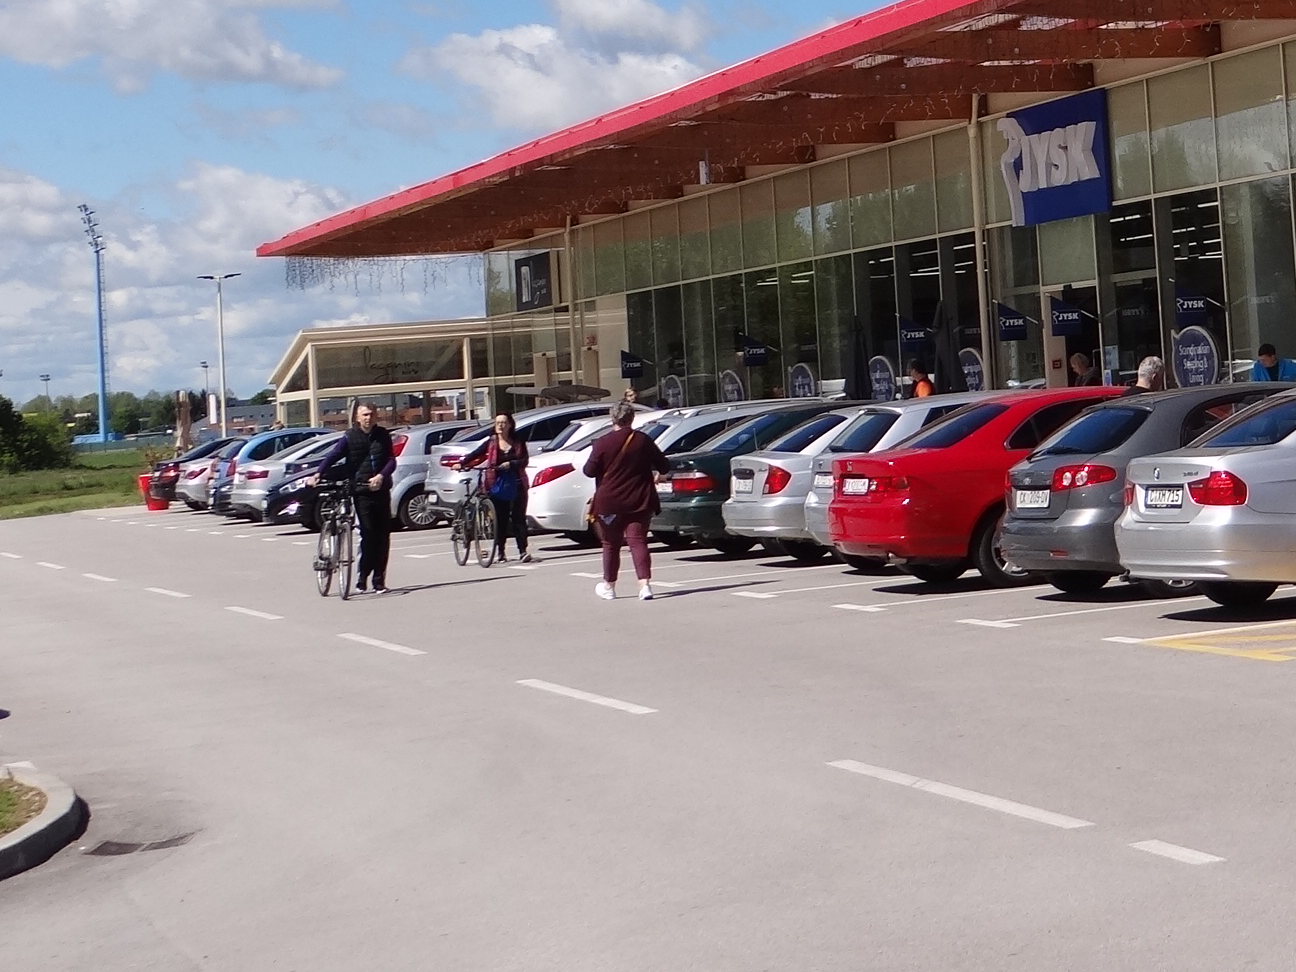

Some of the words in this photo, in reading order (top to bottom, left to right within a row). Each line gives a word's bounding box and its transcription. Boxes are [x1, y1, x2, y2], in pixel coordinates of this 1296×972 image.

[1018, 121, 1101, 193] JYSK
[1182, 300, 1205, 309] JYSK
[1058, 312, 1079, 321] JYSK
[1005, 318, 1025, 327] JYSK
[906, 331, 926, 339] JYSK
